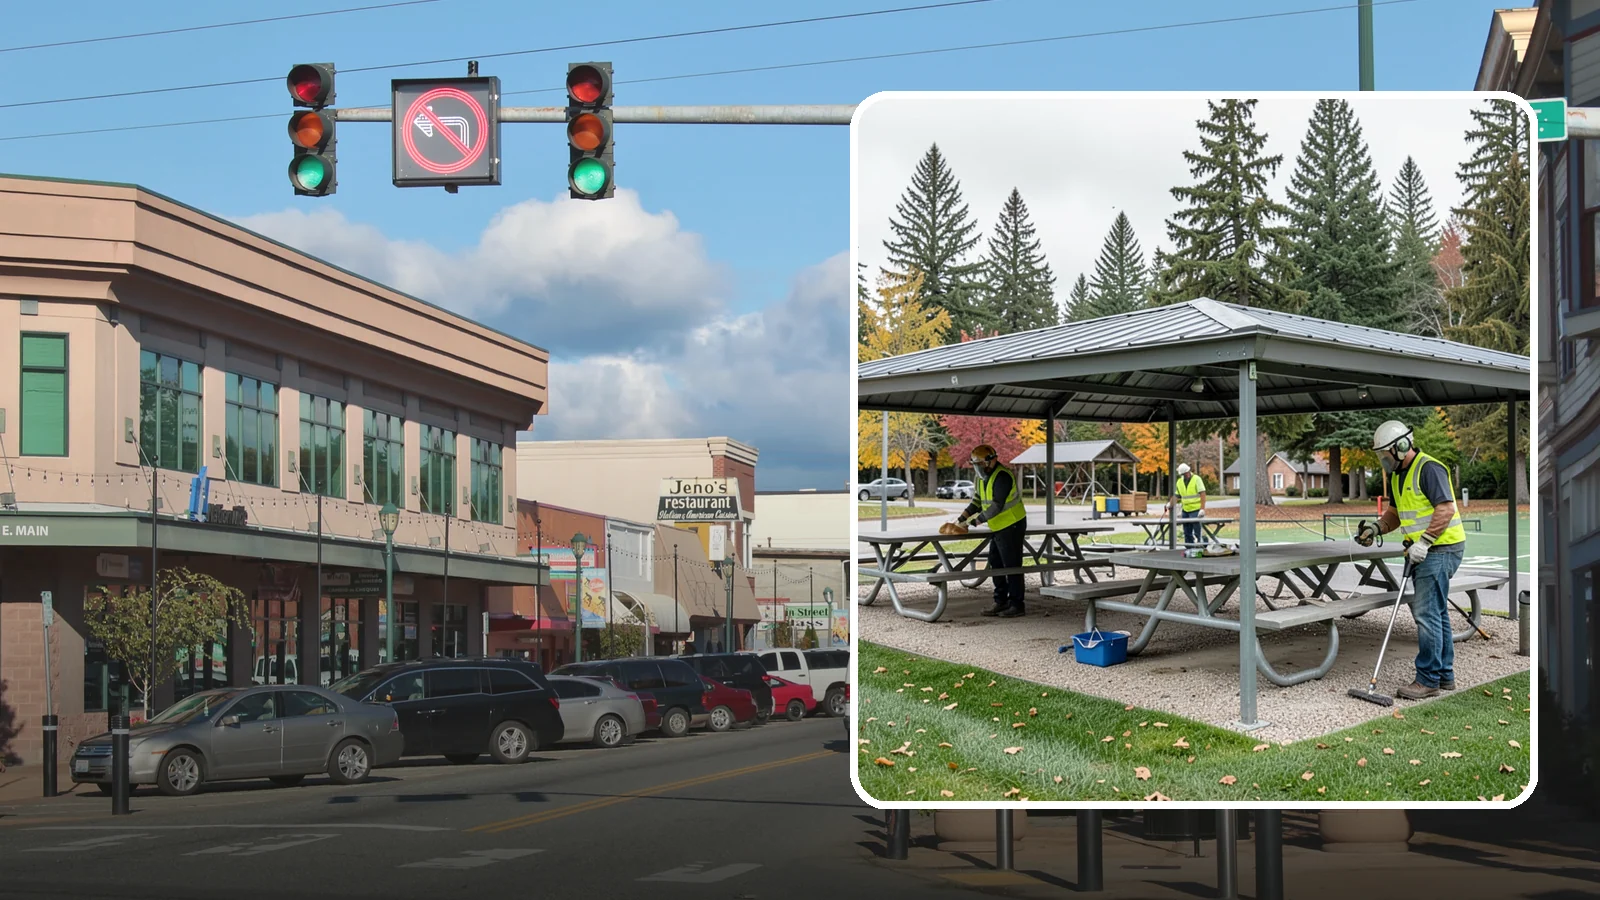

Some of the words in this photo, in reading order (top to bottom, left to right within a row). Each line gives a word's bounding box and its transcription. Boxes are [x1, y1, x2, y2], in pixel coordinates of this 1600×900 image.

[670, 480, 727, 494] Jeno's
[665, 497, 731, 508] restaurant
[659, 510, 681, 519] Italian
[686, 510, 714, 519] American
[715, 509, 737, 519] Cuisine
[2, 525, 13, 536] E.
[15, 525, 49, 536] MAIN
[797, 607, 828, 616] Street
